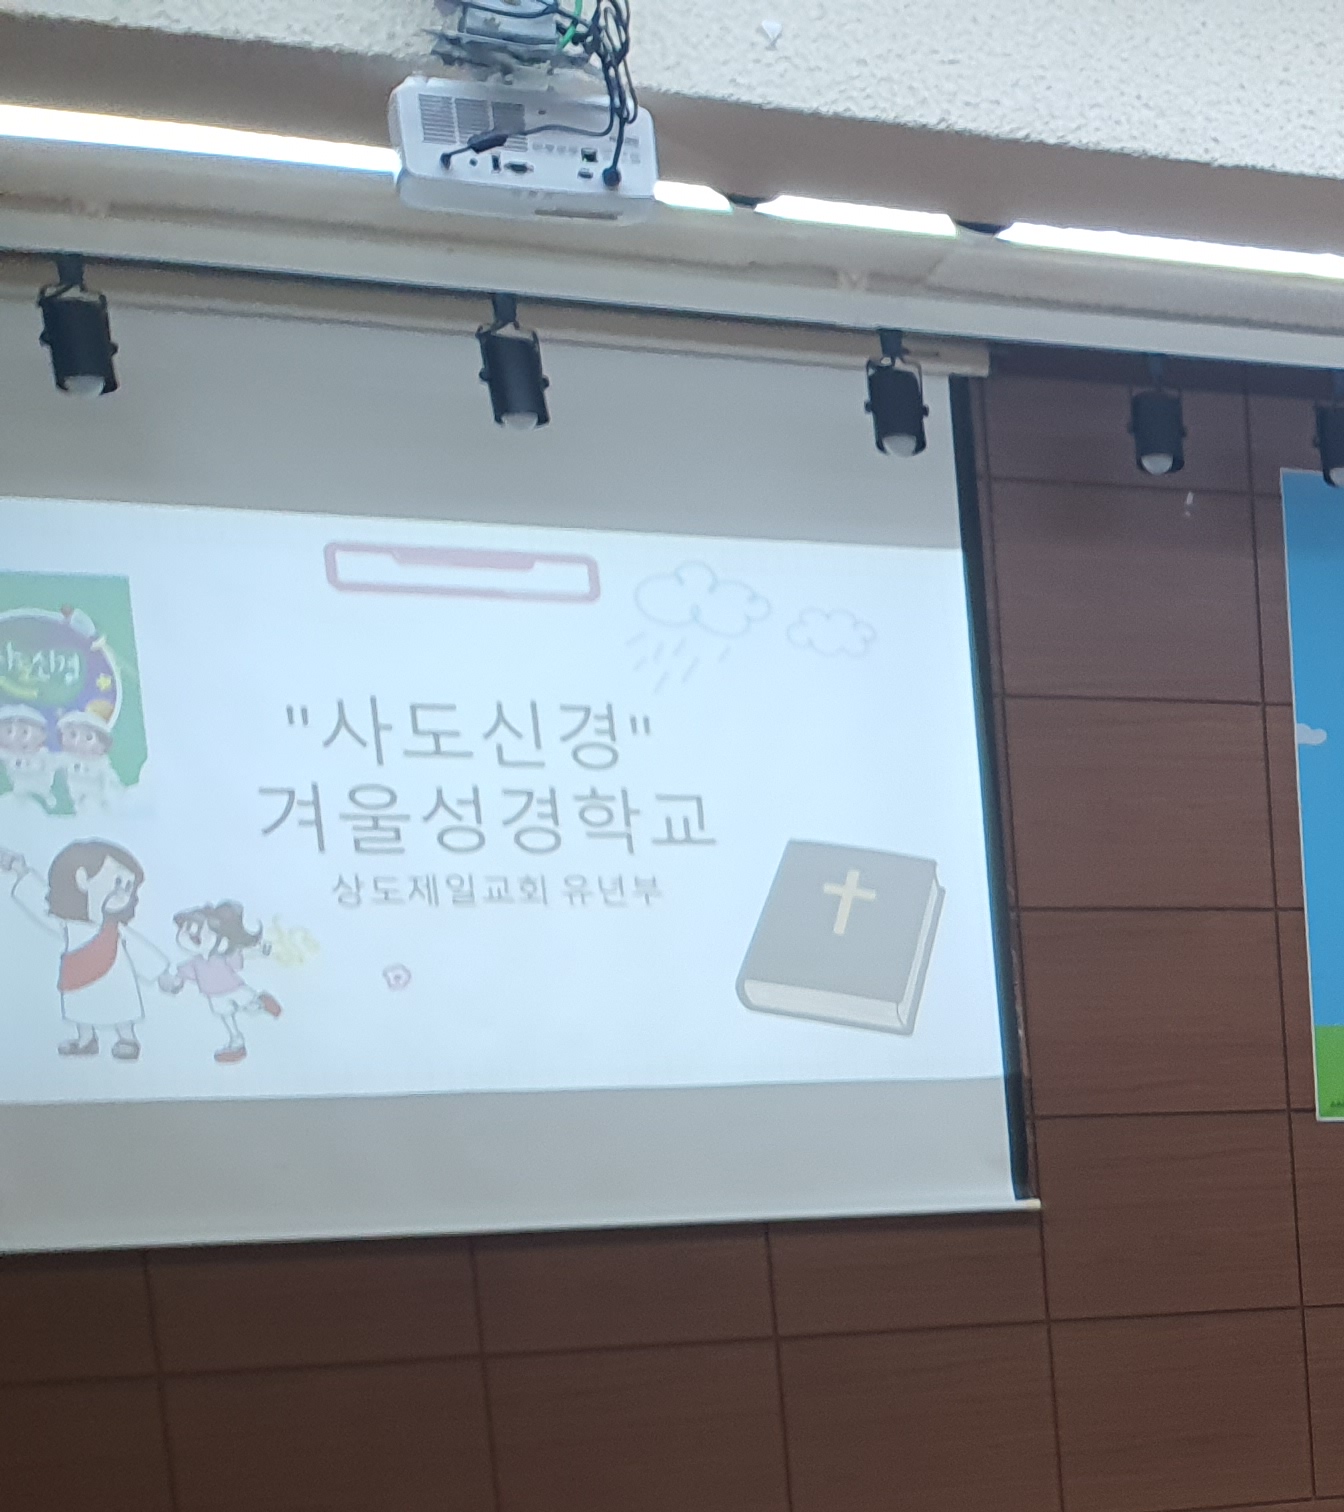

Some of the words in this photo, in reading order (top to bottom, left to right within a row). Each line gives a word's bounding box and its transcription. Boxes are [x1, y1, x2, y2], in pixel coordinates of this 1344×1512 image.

[286, 694, 652, 772] "사도신경"
[258, 782, 718, 856] 겨울성경학교
[332, 872, 551, 908] 상도제일교회
[562, 874, 663, 907] 유년부
